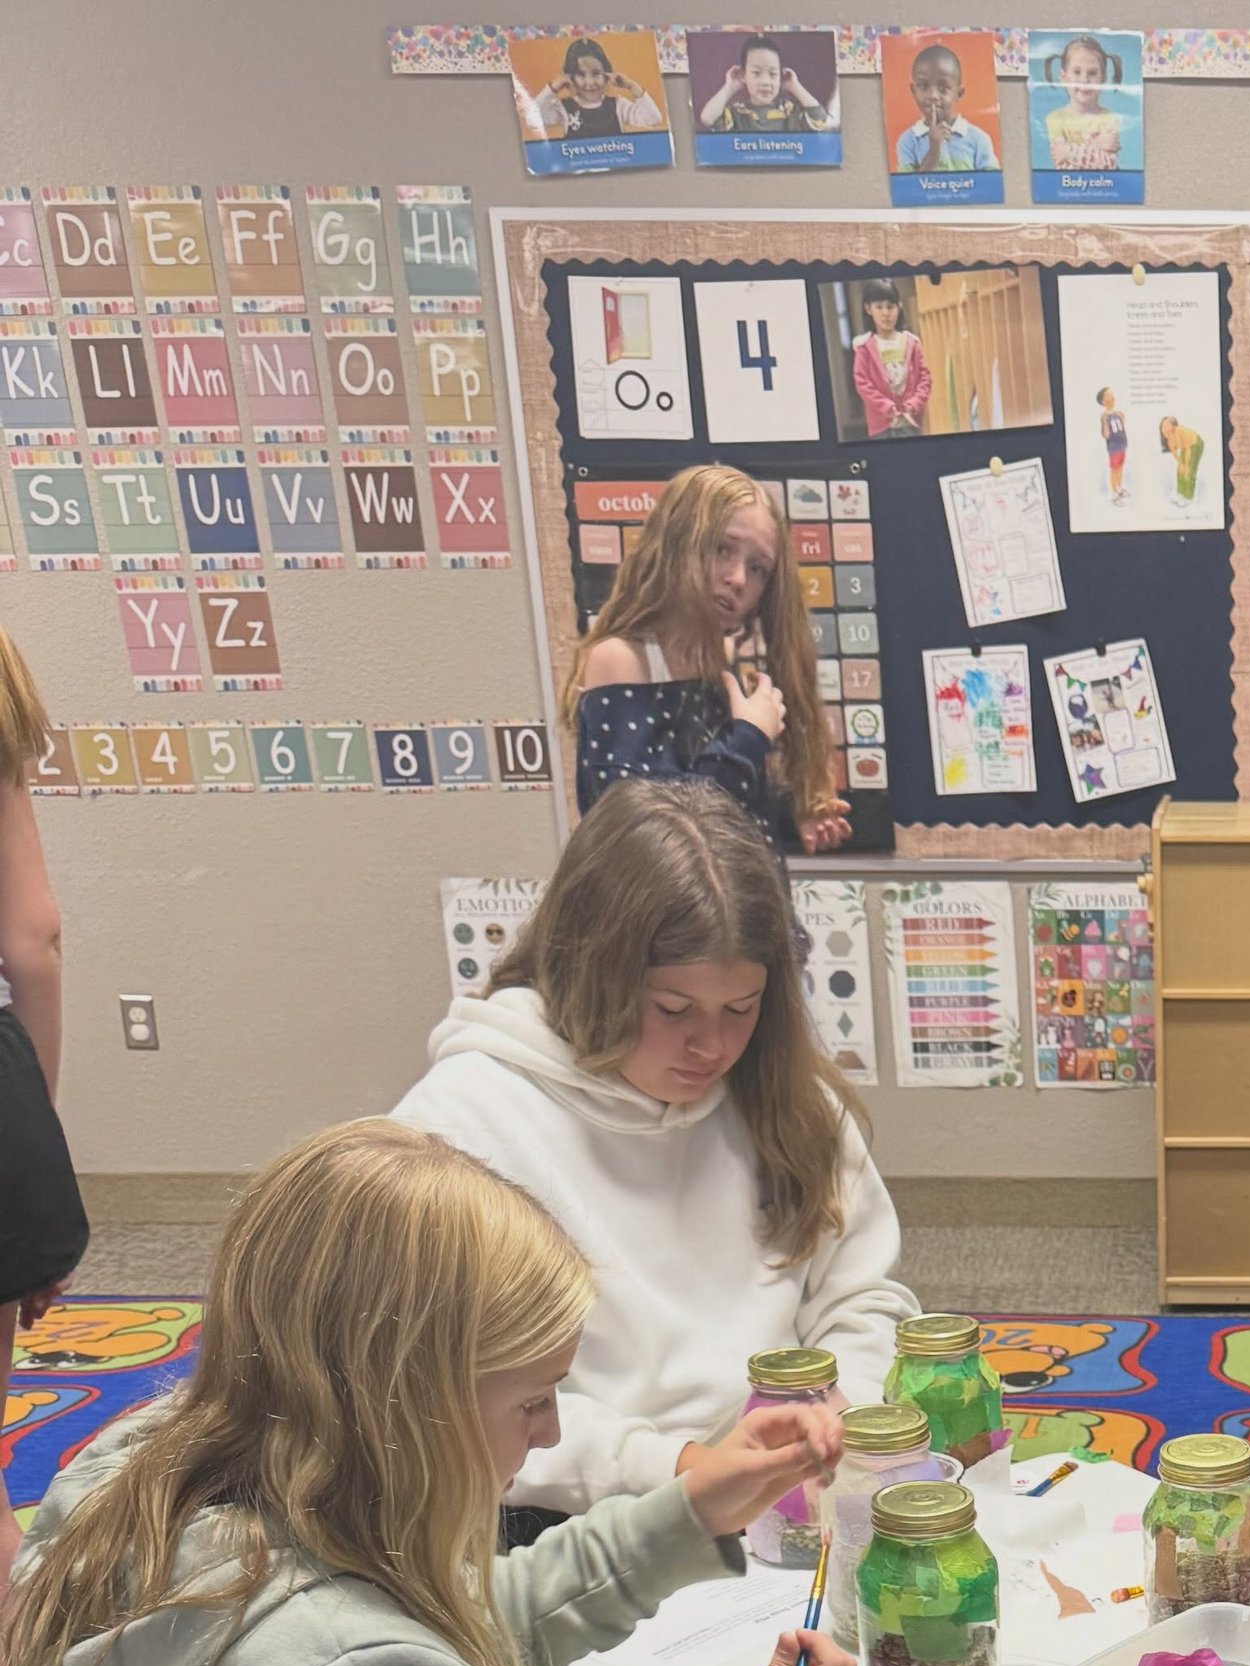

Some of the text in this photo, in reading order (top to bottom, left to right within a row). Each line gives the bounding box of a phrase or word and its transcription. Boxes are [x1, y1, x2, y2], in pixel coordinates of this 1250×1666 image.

[561, 140, 634, 159] Eyes watching
[733, 138, 804, 156] Ears listening
[919, 178, 975, 193] Voice quiet
[1062, 175, 1114, 192] Body calm
[56, 211, 117, 267] Dd
[143, 211, 201, 266] Ee
[229, 210, 284, 266] Ff
[317, 211, 377, 292] Gg
[411, 210, 471, 266] Hh
[1, 346, 58, 399] Kk
[89, 345, 137, 398] Ll
[167, 344, 228, 397] Mm
[252, 344, 310, 397] Nn
[339, 342, 395, 396] Oo
[736, 320, 777, 391] 4
[430, 343, 481, 422] Pp
[28, 475, 81, 525] Ss
[102, 474, 161, 525] Tt
[188, 474, 245, 525] Uu
[271, 473, 325, 524] Vv
[351, 473, 414, 524] Ww
[440, 472, 497, 524] Xx
[598, 492, 657, 511] octob
[801, 541, 821, 555] fri
[808, 580, 820, 596] 2
[850, 577, 863, 594] 3
[127, 599, 186, 672] Yy
[209, 598, 268, 647] Zz
[848, 624, 870, 642] 10
[851, 671, 872, 688] 17
[38, 733, 61, 775] 2
[93, 733, 119, 775] 3
[151, 731, 178, 775] 4
[207, 730, 236, 774] 5
[270, 730, 296, 774] 6
[326, 731, 353, 775] 7
[392, 733, 418, 777] 8
[449, 730, 474, 775] 9
[503, 728, 543, 773] 10
[457, 898, 534, 912] EMOTIO
[805, 913, 835, 926] PES
[913, 901, 983, 915] COLORS
[1066, 894, 1147, 907] ALPHABET
[924, 917, 961, 931] RED
